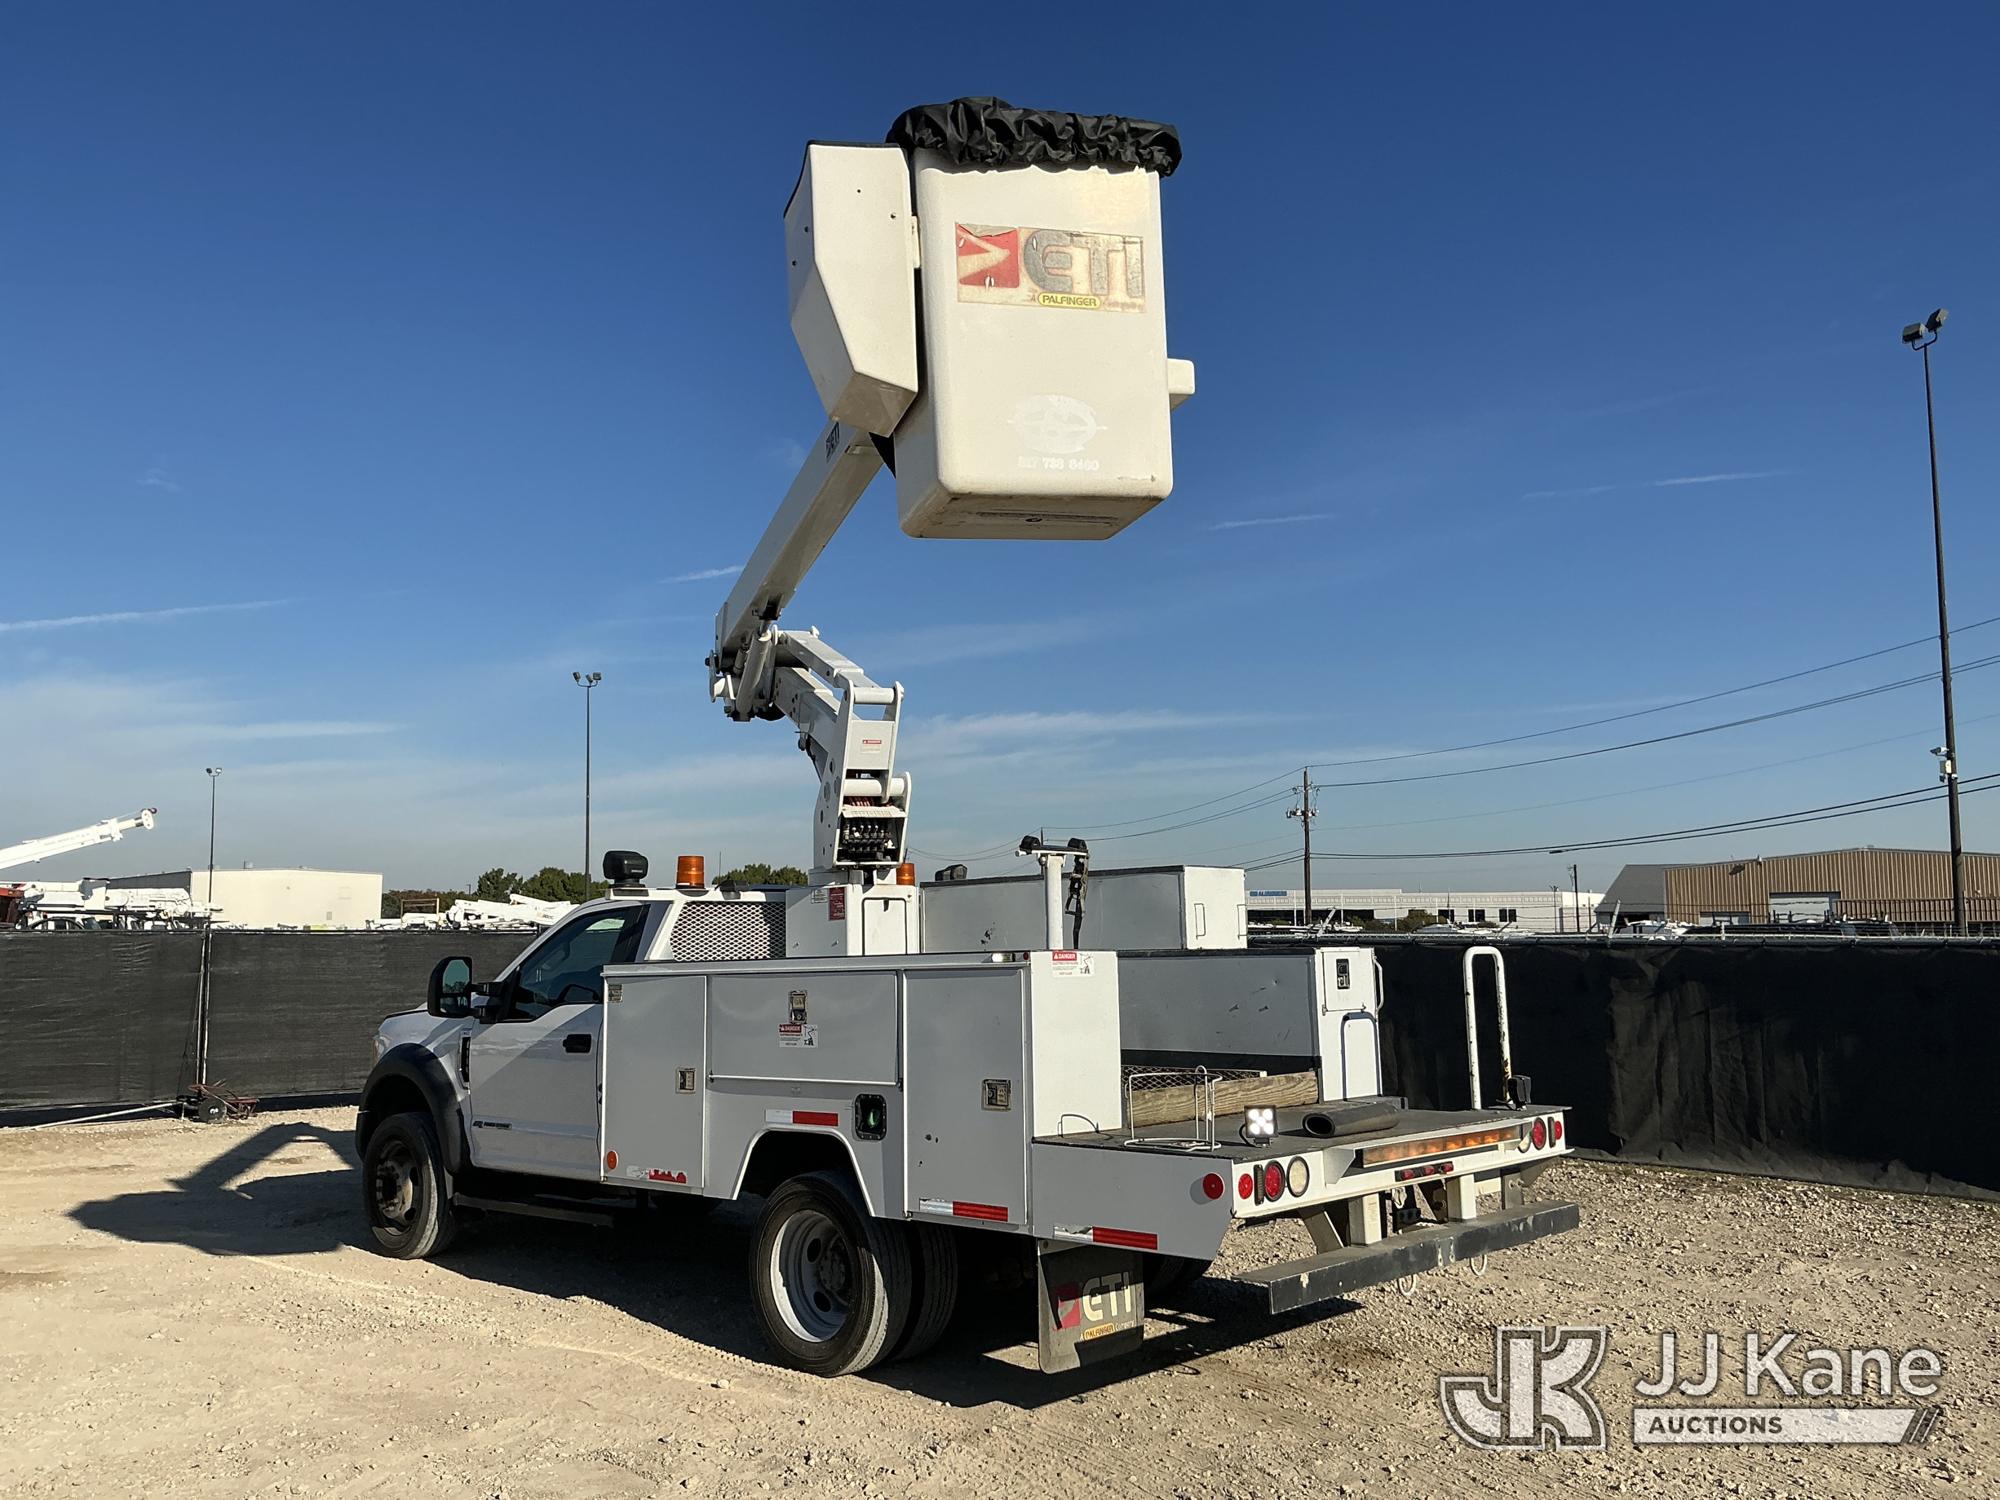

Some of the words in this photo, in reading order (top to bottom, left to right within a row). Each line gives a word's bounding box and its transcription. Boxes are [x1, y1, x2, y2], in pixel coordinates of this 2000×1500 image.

[1024, 229, 1144, 298] ETI
[1042, 295, 1097, 307] PALFINGER
[1082, 1271, 1131, 1321] ETI
[1086, 1325, 1114, 1338] PALFINGER
